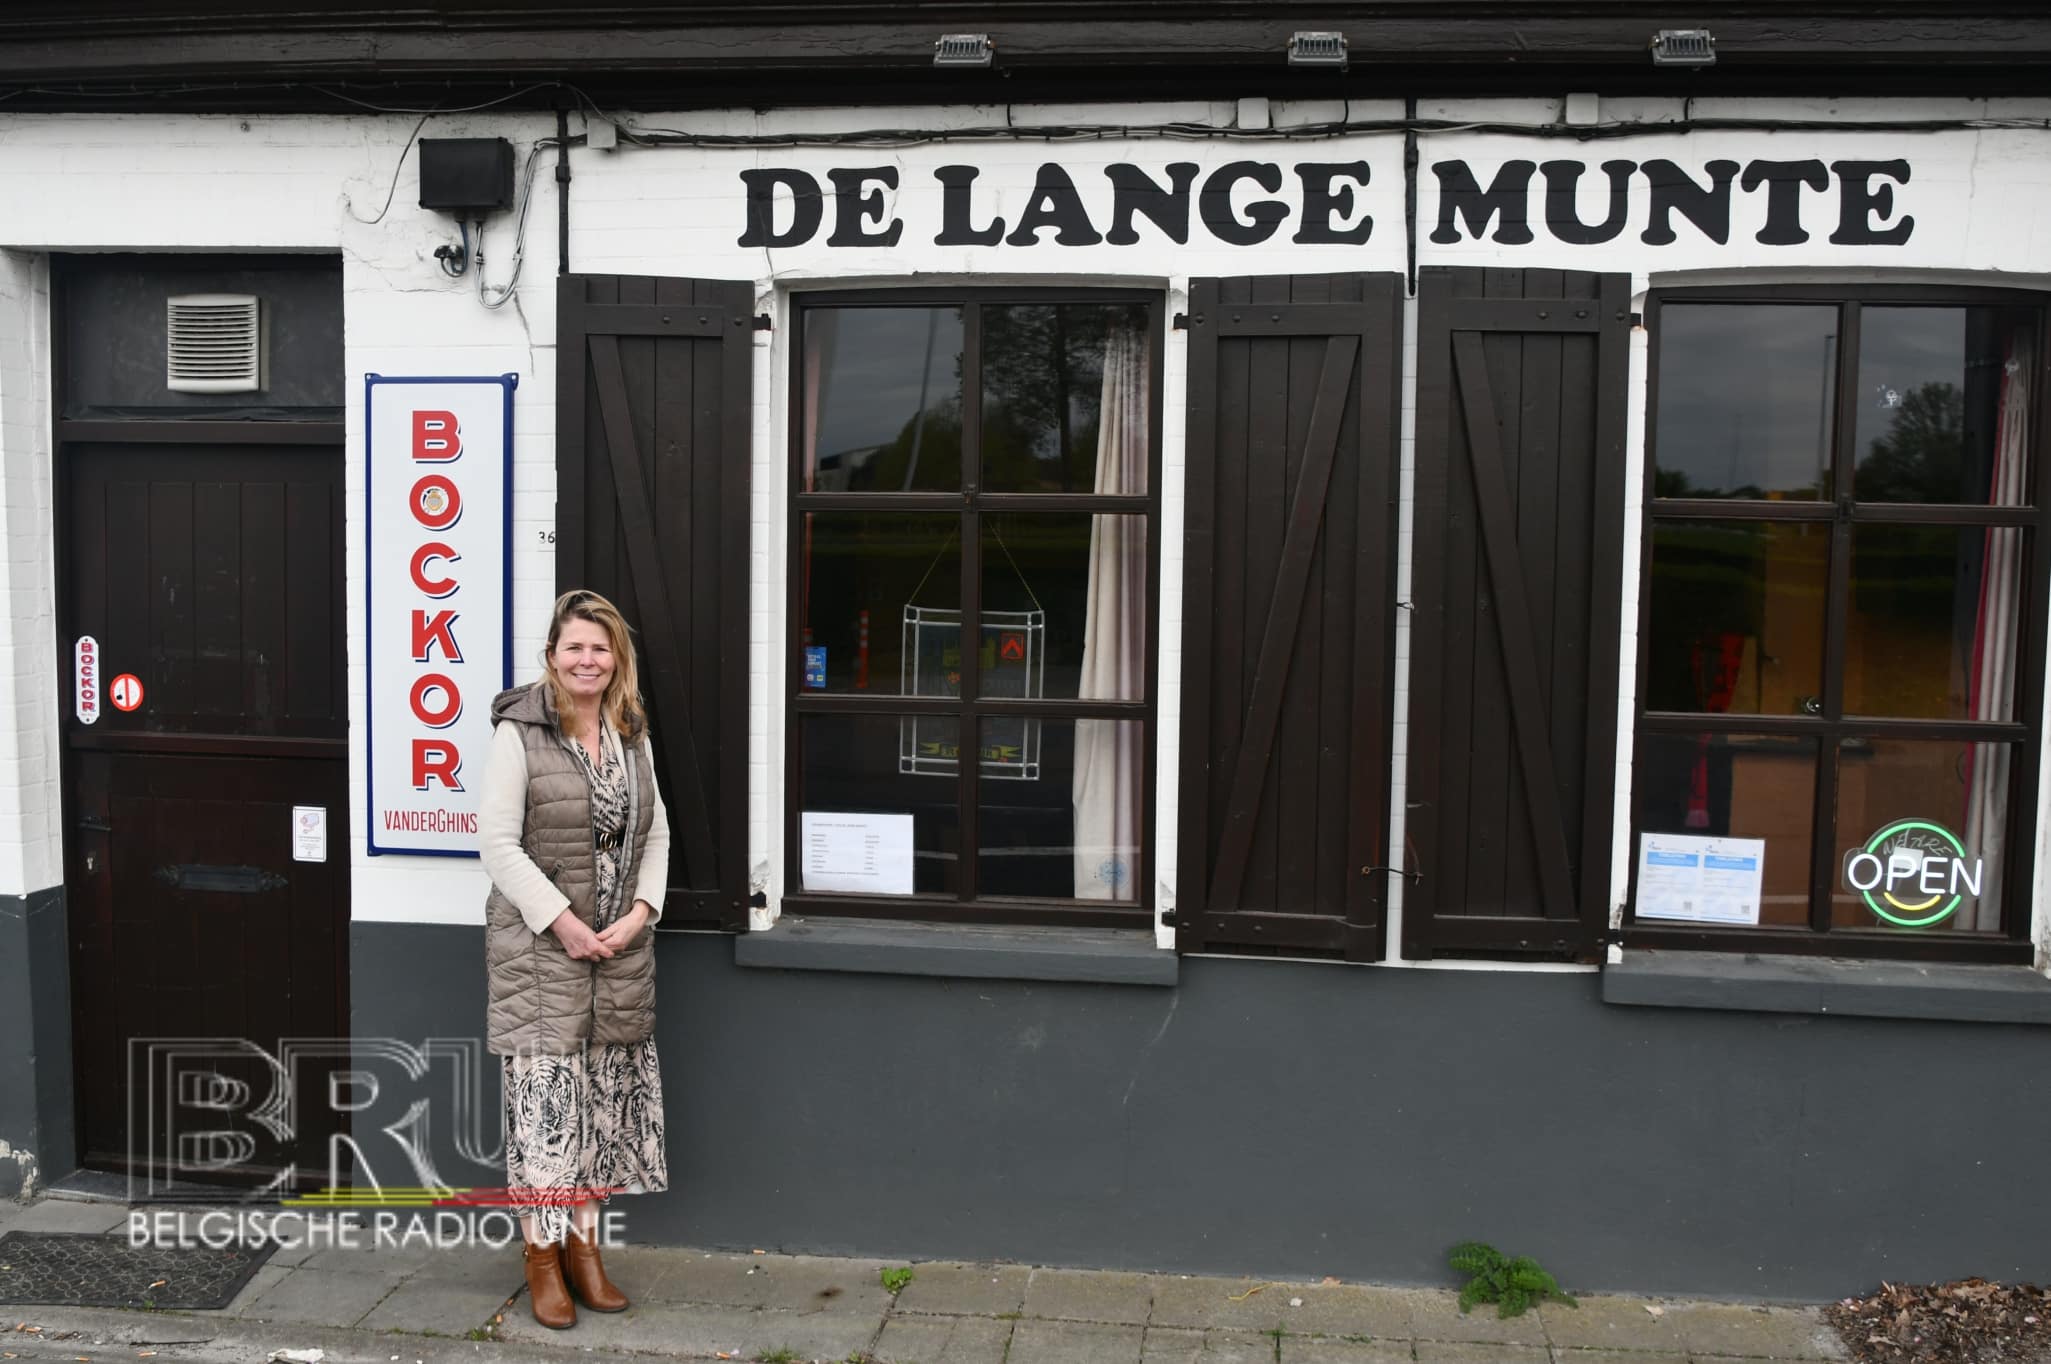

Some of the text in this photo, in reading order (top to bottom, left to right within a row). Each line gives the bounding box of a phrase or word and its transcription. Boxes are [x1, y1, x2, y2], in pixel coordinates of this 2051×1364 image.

[737, 158, 1915, 247] DE LANGE MUNTE
[409, 410, 465, 792] BOCKOR
[81, 643, 96, 712] BOCKOR
[384, 808, 479, 834] VANDERGHINS
[1847, 853, 1982, 897] OPEN
